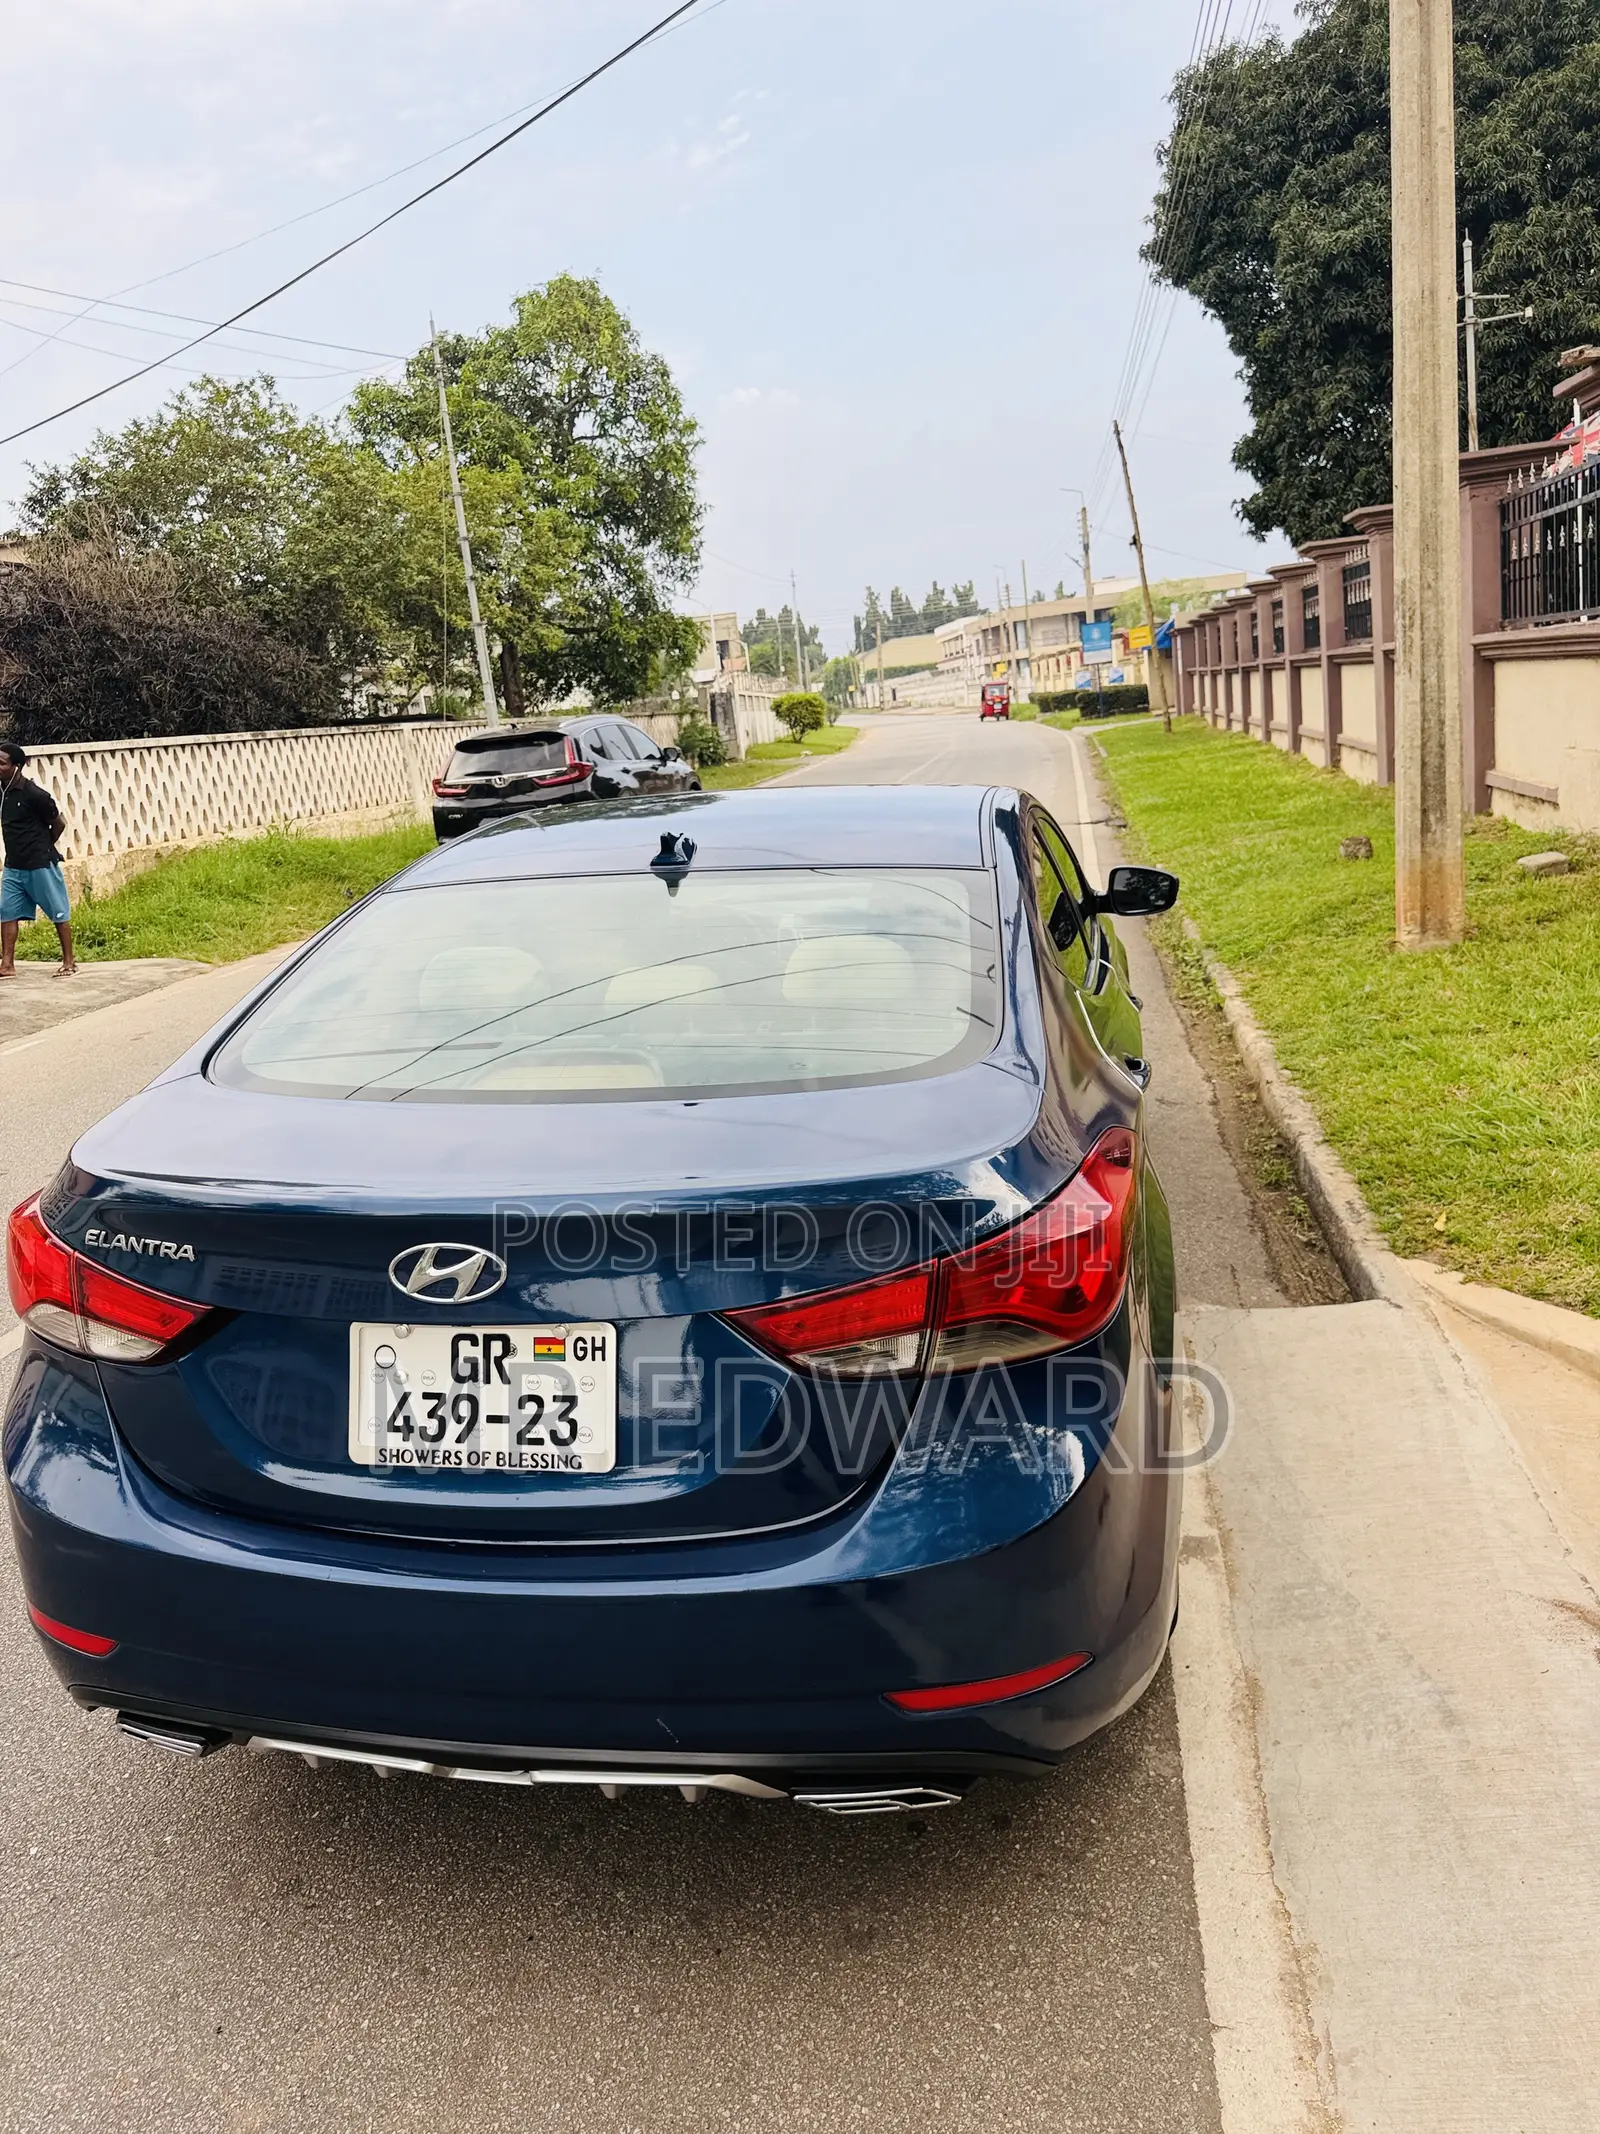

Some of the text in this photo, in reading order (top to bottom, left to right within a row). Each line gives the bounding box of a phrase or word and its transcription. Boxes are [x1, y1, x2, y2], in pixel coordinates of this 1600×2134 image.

[84, 1228, 196, 1263] ELANTRA
[451, 1333, 511, 1386] GR
[573, 1336, 606, 1362] GH
[387, 1391, 579, 1447] 439-23
[378, 1447, 582, 1470] SHOWERS OF BLESSING
